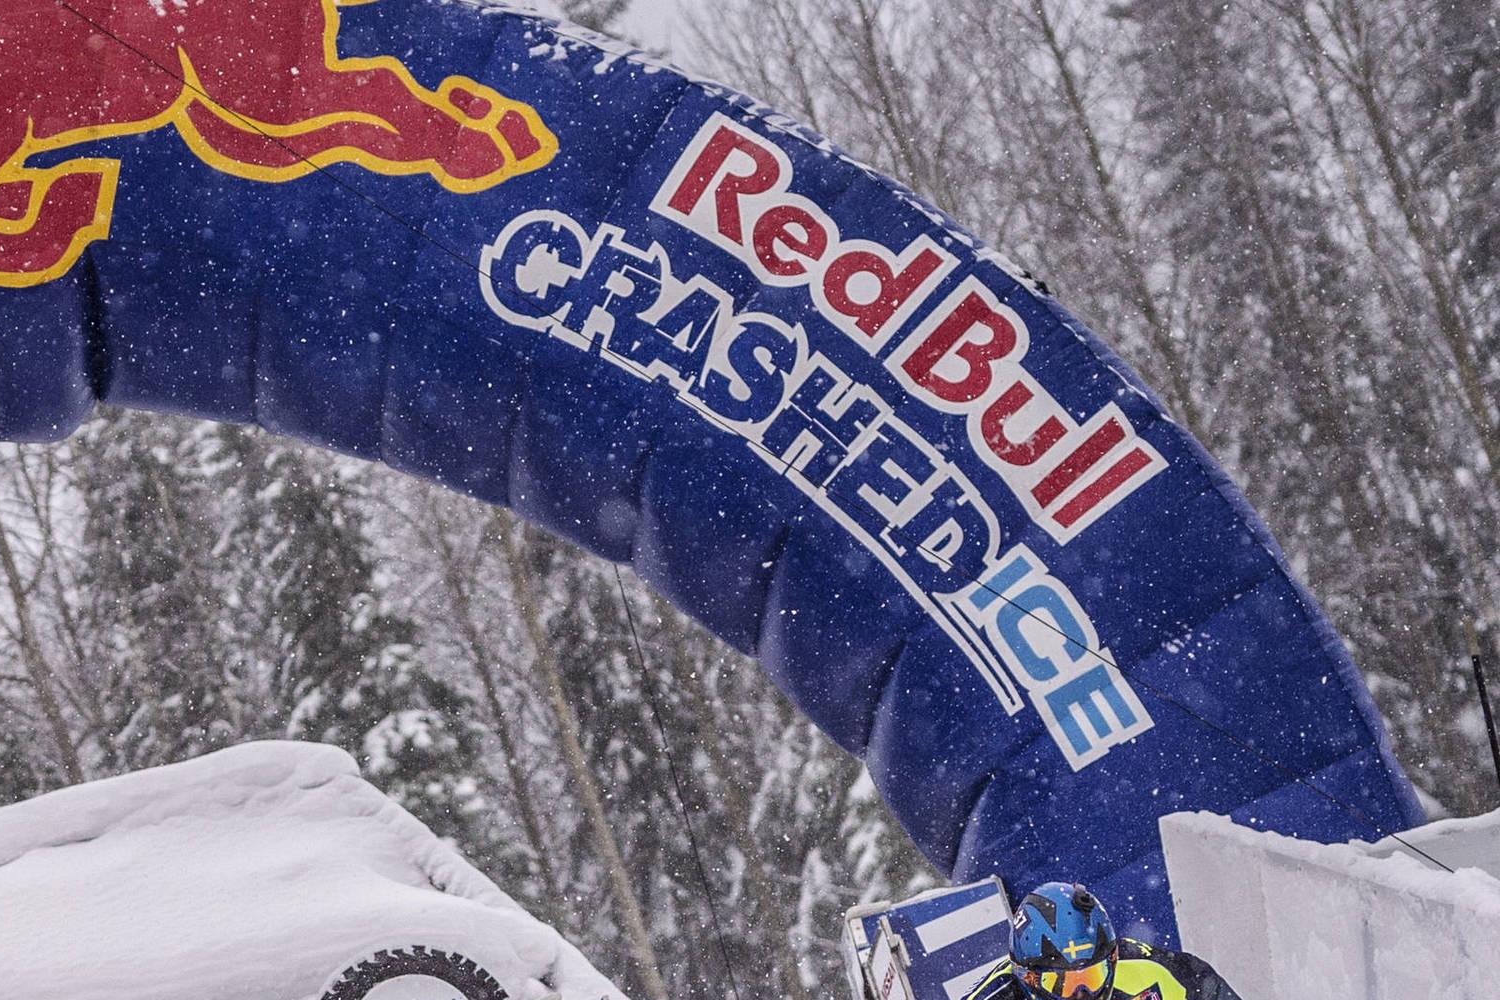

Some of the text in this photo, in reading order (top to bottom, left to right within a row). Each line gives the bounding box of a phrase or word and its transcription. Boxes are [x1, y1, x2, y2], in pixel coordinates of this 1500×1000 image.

[479, 209, 1152, 769] CRASHED ICE
[657, 117, 1162, 541] Red Bull
